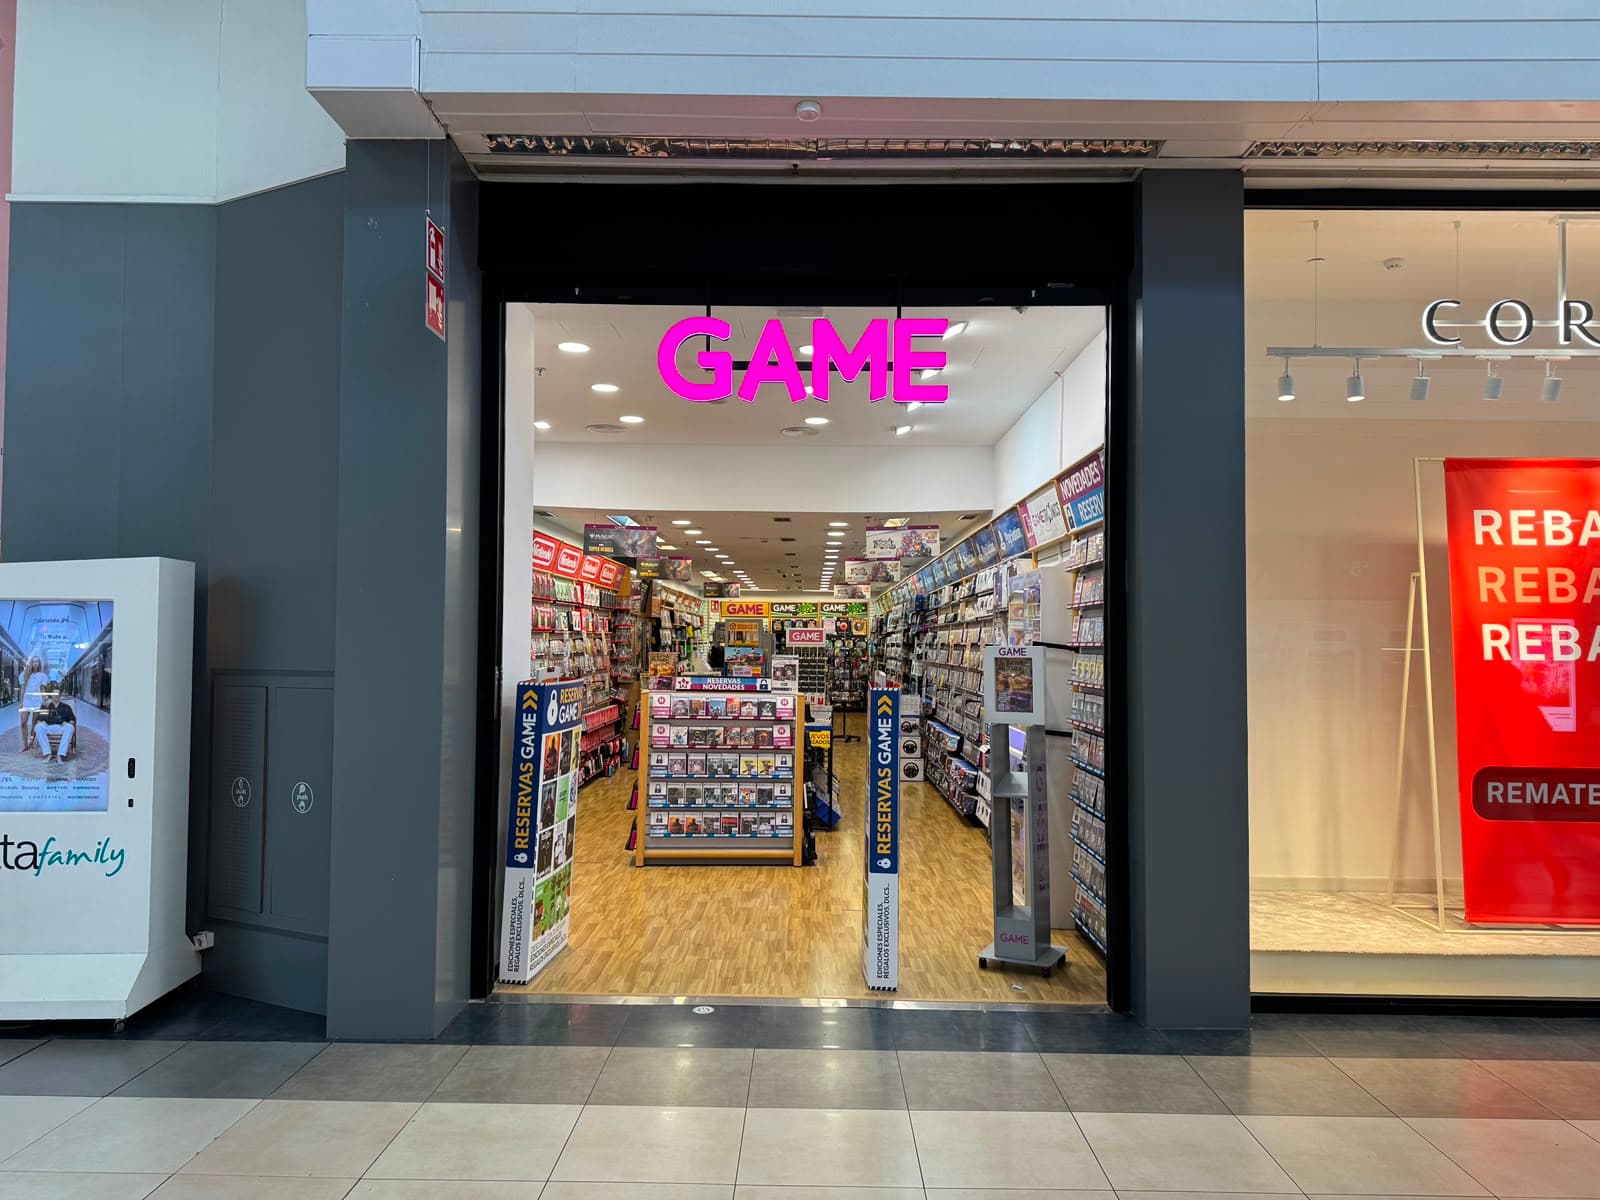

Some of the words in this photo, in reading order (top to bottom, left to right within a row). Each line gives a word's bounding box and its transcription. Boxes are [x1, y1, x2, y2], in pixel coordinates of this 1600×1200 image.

[1421, 299, 1600, 347] COR
[657, 315, 949, 403] GAME
[1059, 461, 1101, 501] NOVEDADES
[726, 603, 764, 615] GAME
[773, 604, 796, 612] GAME
[822, 604, 847, 612] GAME
[792, 632, 820, 641] GAME
[998, 647, 1027, 656] GAME
[559, 703, 578, 724] GAME
[521, 712, 537, 760] GAME
[877, 717, 892, 766] GAME
[515, 763, 534, 849] RESERVAS
[1487, 782, 1600, 806] REMATE
[877, 768, 892, 856] RESERVAS
[1000, 932, 1029, 945] GAME
[507, 937, 515, 972] EDICIONES
[513, 942, 521, 973] REGALOS
